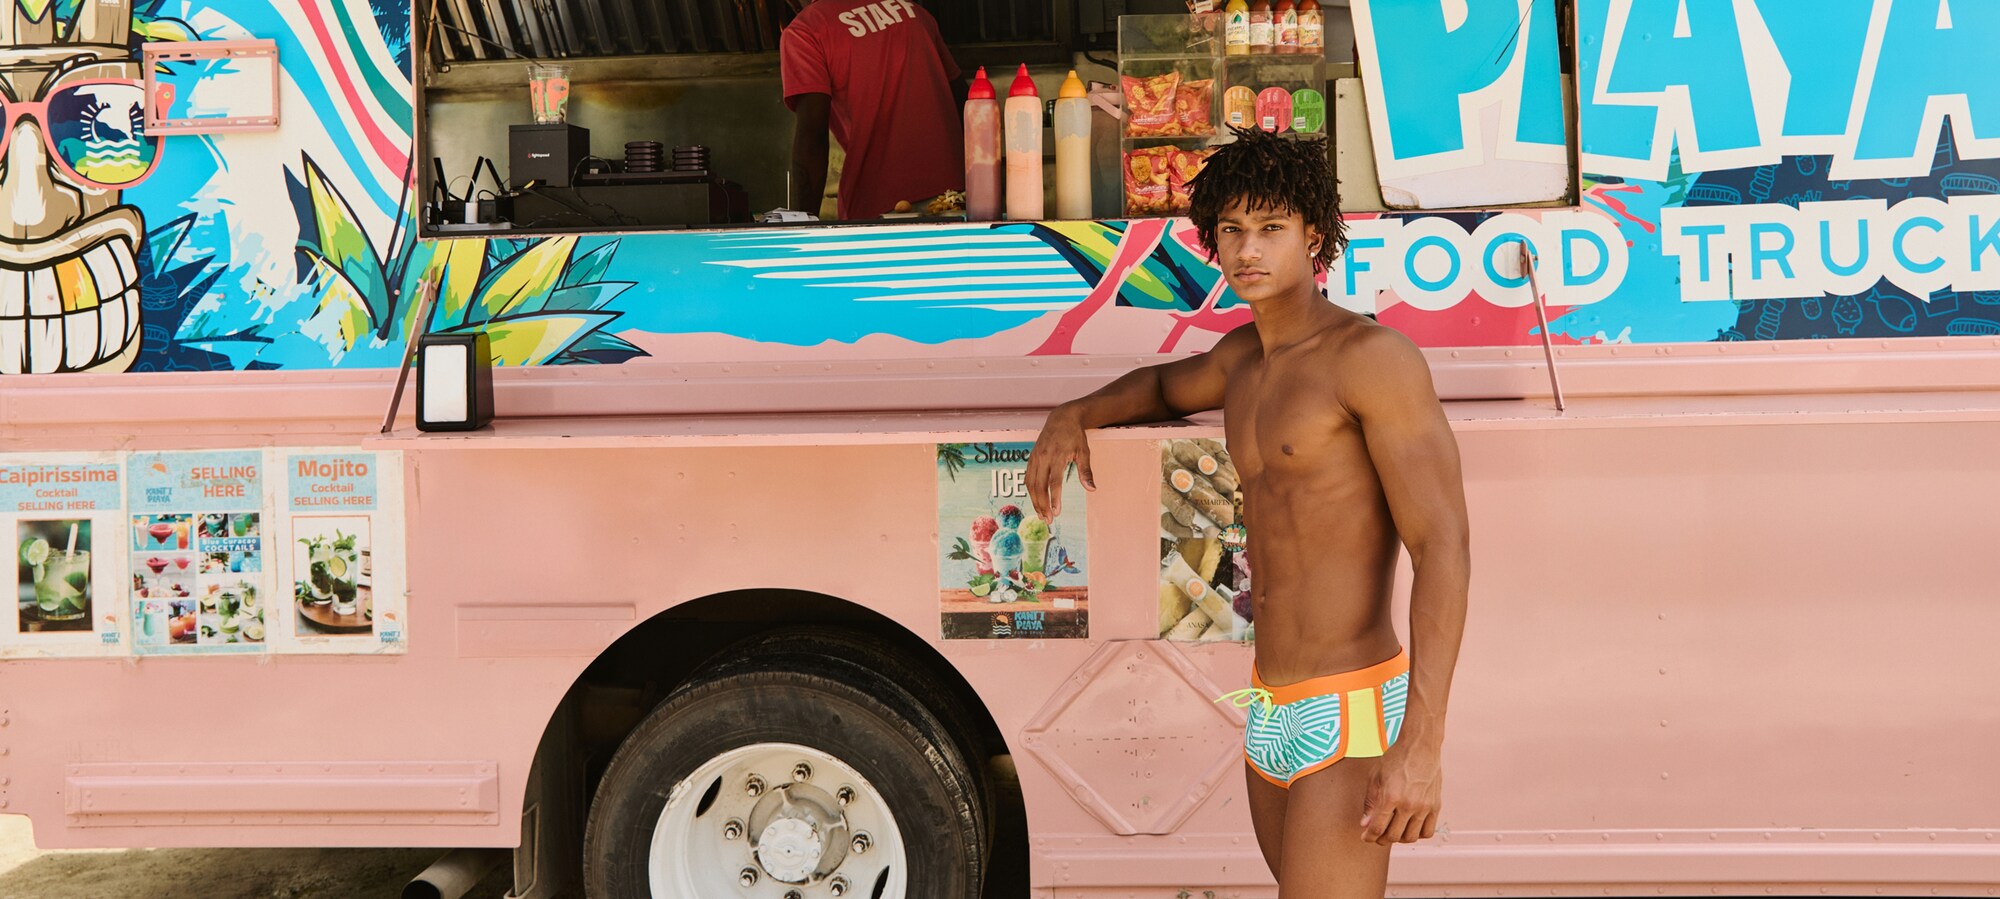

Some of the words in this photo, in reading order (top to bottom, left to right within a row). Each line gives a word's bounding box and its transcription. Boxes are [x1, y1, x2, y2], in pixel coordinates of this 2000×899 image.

[838, 0, 916, 38] STAFF
[1365, 0, 2000, 162] PLAYA
[1344, 229, 1609, 296] FOOD
[1681, 214, 2000, 283] TRUCK
[0, 466, 118, 487] Caipirissima
[191, 465, 257, 480] SELLING
[298, 459, 368, 481] Mojito
[311, 483, 354, 493] Cocktail
[991, 468, 1028, 498] ICE
[35, 488, 78, 498] Cocktail
[203, 484, 246, 498] HERE
[17, 501, 64, 511] SELLING
[67, 500, 96, 510] HERE
[294, 496, 339, 506] SELLING
[343, 495, 372, 505] HERE
[204, 544, 255, 552] COCKTAILS
[1015, 620, 1044, 630] PLAYA
